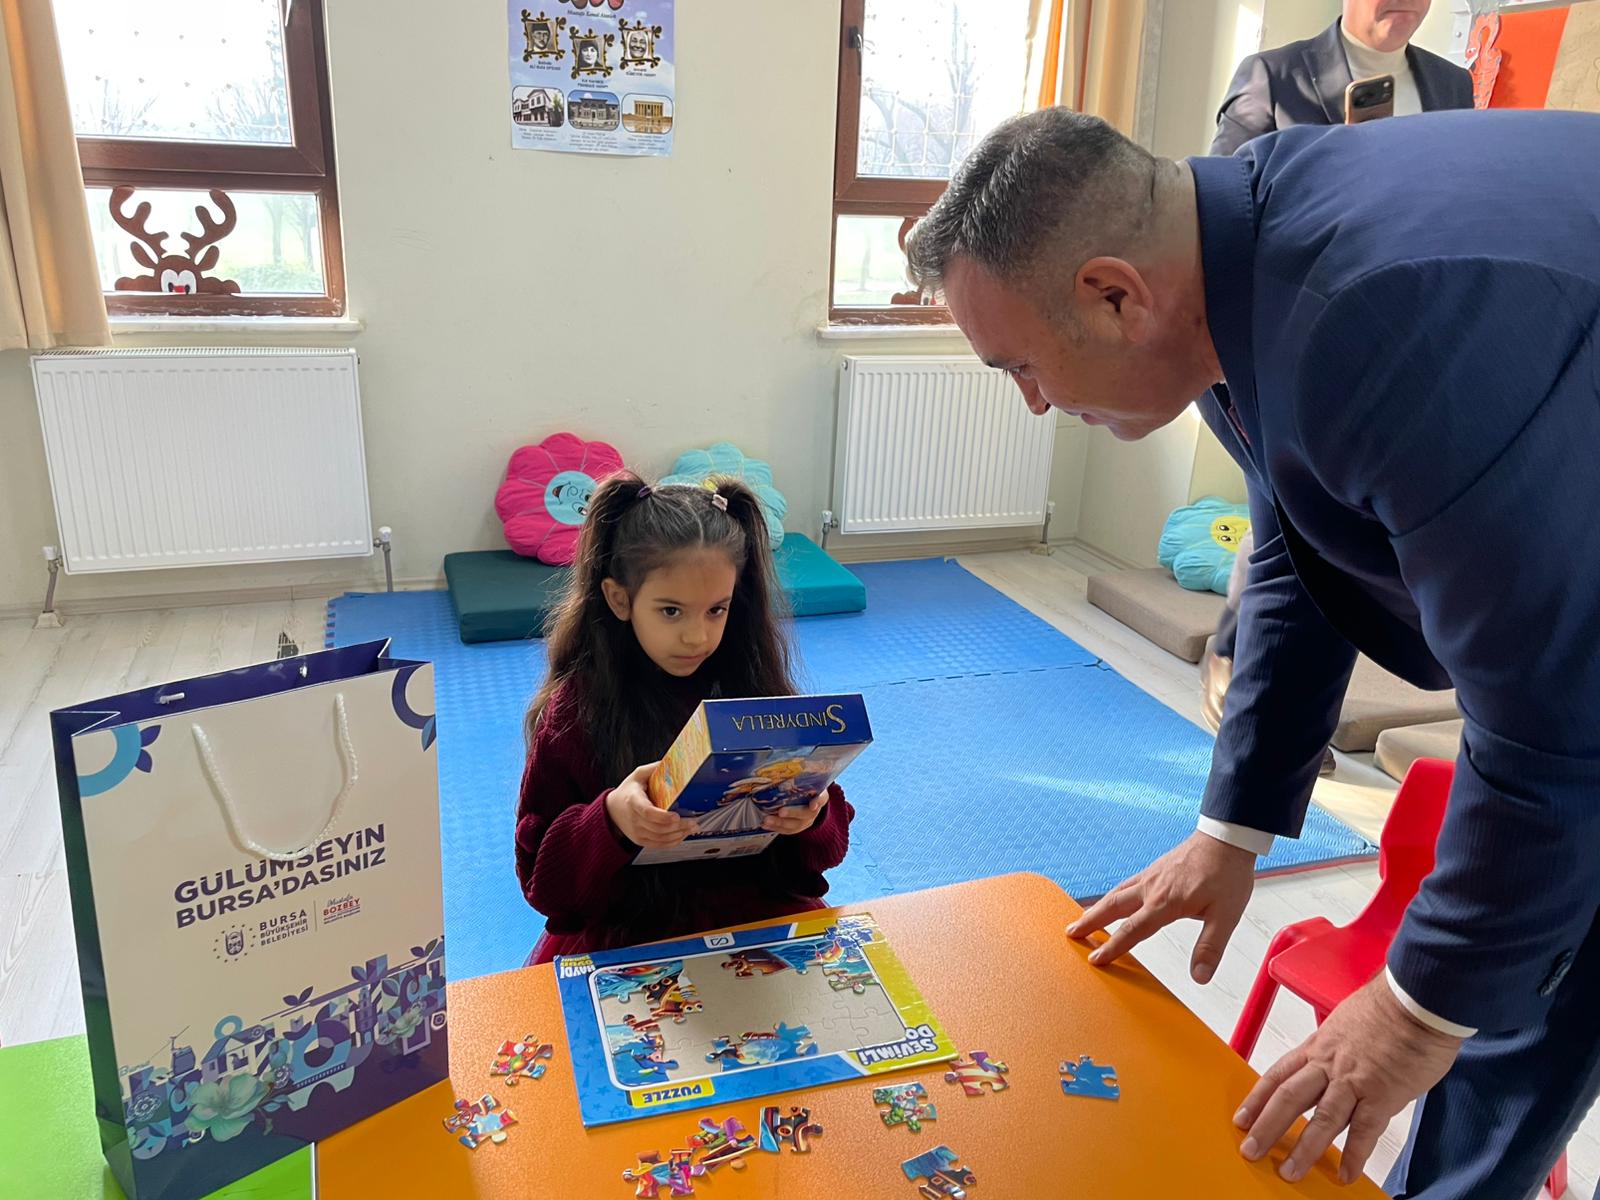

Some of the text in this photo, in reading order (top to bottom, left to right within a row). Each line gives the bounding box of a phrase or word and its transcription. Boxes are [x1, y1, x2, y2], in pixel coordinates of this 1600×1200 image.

[731, 703, 847, 734] SINDYRELLA
[323, 898, 361, 916] BOZBEY
[259, 909, 307, 931] BURSA
[261, 923, 309, 946] BELEDİYESİ
[641, 1084, 702, 1104] PUZZLE
